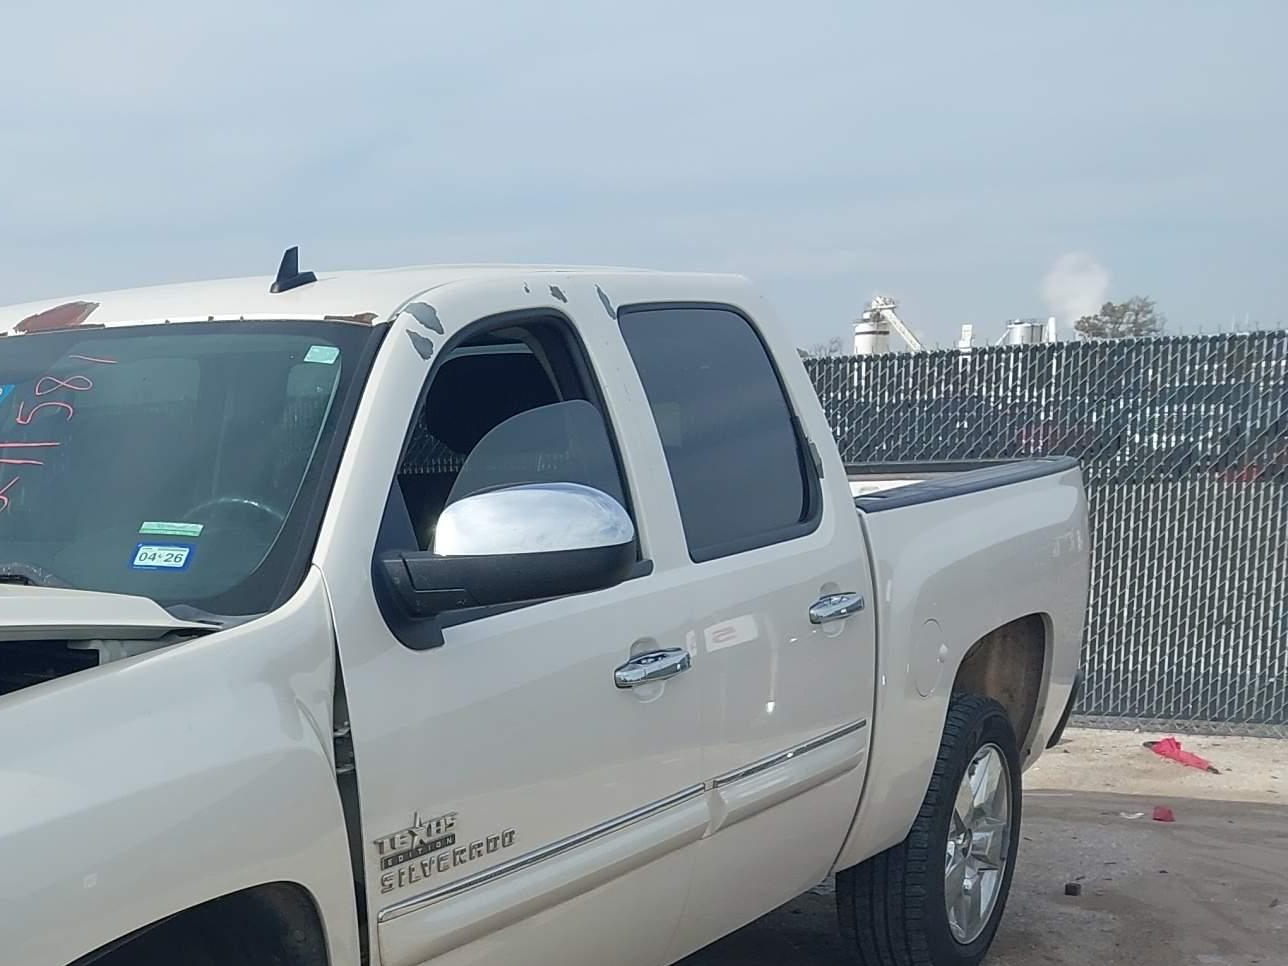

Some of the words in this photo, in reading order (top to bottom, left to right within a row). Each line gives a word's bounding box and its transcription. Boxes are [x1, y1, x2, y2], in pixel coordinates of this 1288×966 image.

[138, 552, 157, 562] 04
[163, 553, 184, 563] 26
[373, 811, 459, 854] TEXAS
[385, 834, 455, 868] EDITION
[380, 828, 516, 893] SILVERADO
